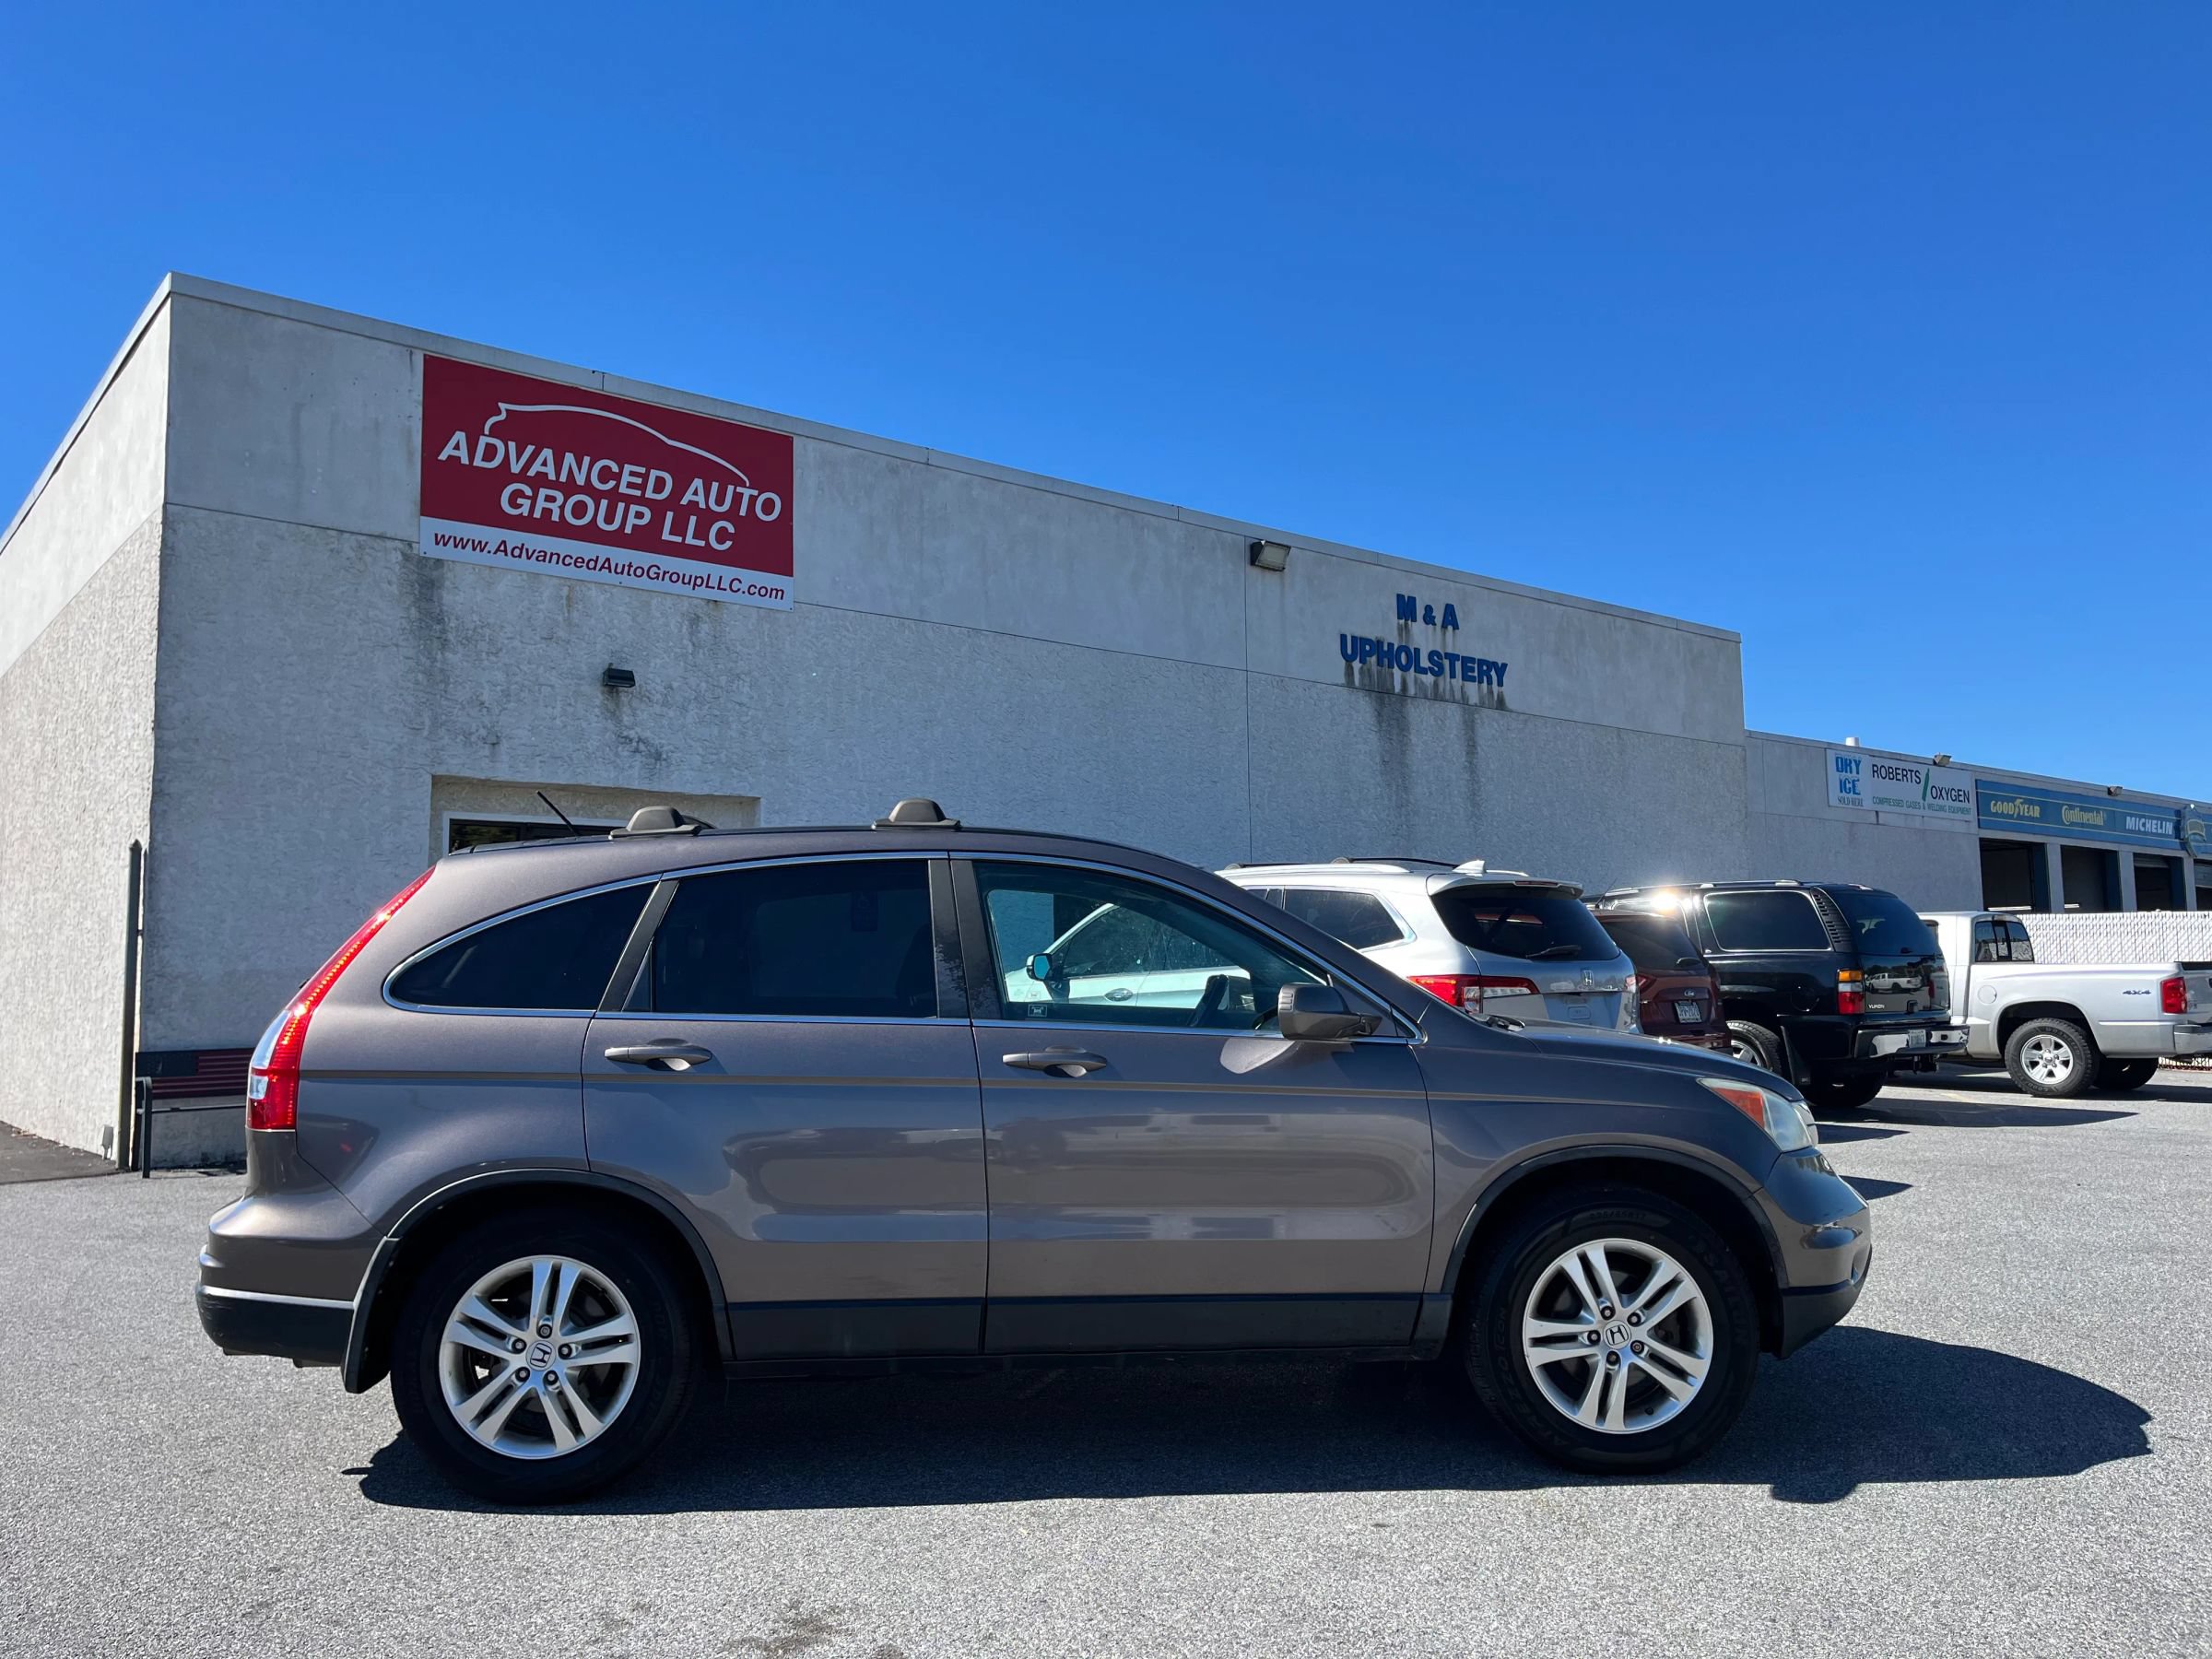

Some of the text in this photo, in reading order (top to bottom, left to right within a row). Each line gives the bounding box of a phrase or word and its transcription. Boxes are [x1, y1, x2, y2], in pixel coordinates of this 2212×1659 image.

[438, 430, 782, 522] ADVANCED AUTO
[500, 483, 735, 550] GROUP LLC
[434, 532, 785, 601] www.AdvancedAutoGroupLLC.com
[1396, 594, 1459, 629] M & A
[1340, 634, 1508, 687] UPHOLSTERY
[1835, 756, 1862, 775] DRY
[1872, 764, 1921, 784] ROBERTS
[1839, 777, 1861, 795] ICE
[1930, 785, 1970, 804] OXYGEN
[1872, 796, 1904, 808] COMPRESSED
[1906, 799, 1921, 810] GASES
[1927, 803, 1947, 813] WELDING
[1947, 806, 1971, 816] EQUIPMENT
[1990, 798, 2041, 818] GOODYEAR
[2062, 805, 2104, 826] Continental
[2125, 816, 2173, 835] MICHELIN
